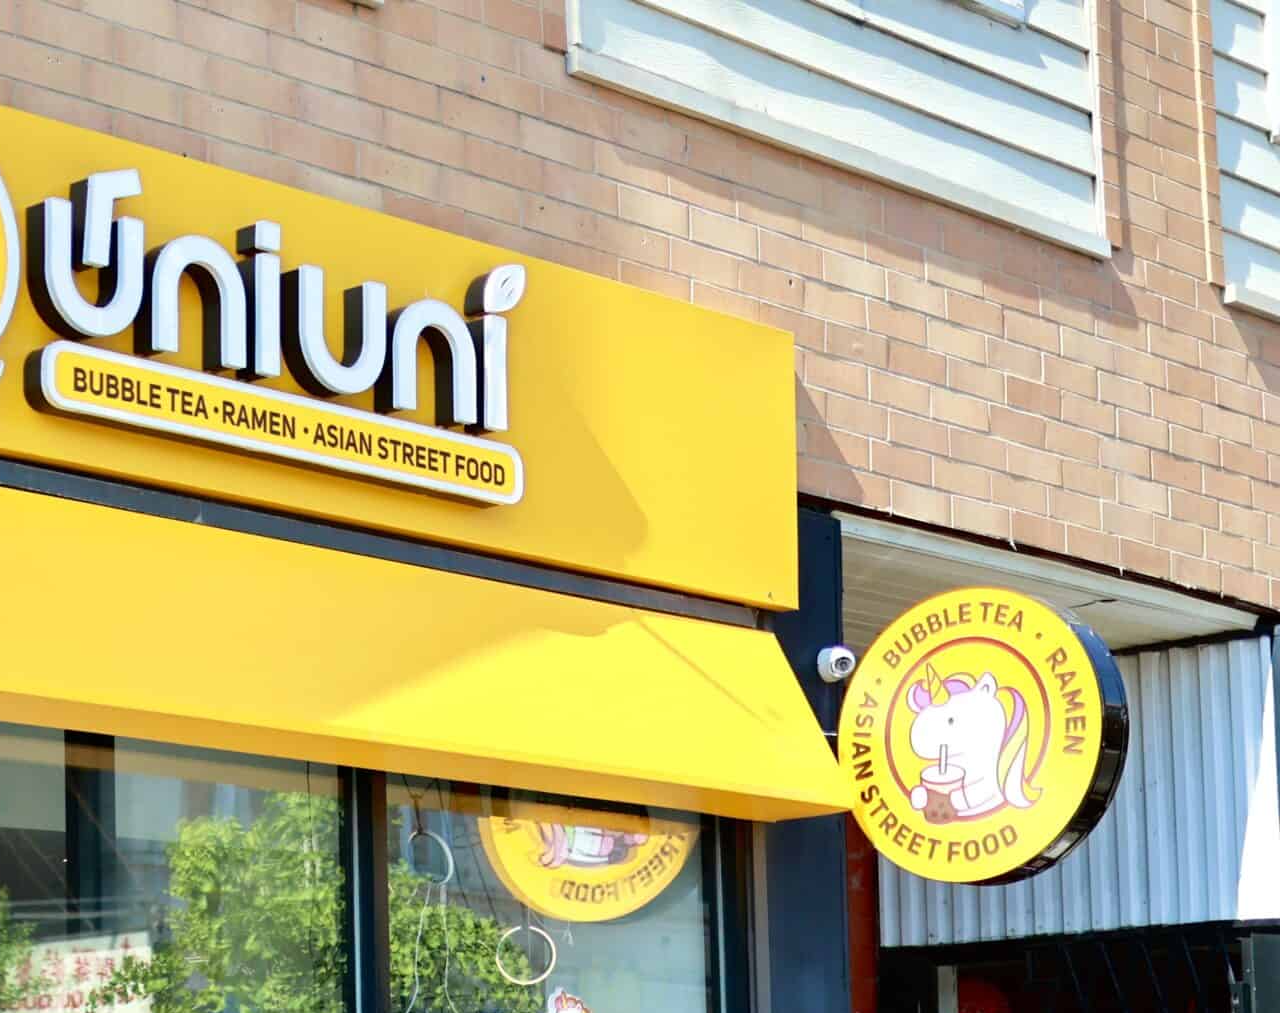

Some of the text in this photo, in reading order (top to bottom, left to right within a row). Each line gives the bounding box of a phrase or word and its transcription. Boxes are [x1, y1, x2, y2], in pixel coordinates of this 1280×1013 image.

[72, 366, 506, 487] BUBBLE TEA RAMEN ASIAN STREET FOOD
[882, 601, 1087, 756] BUBBLE TEA RAMEN
[851, 690, 1019, 864] ASIAN STREET FOOD
